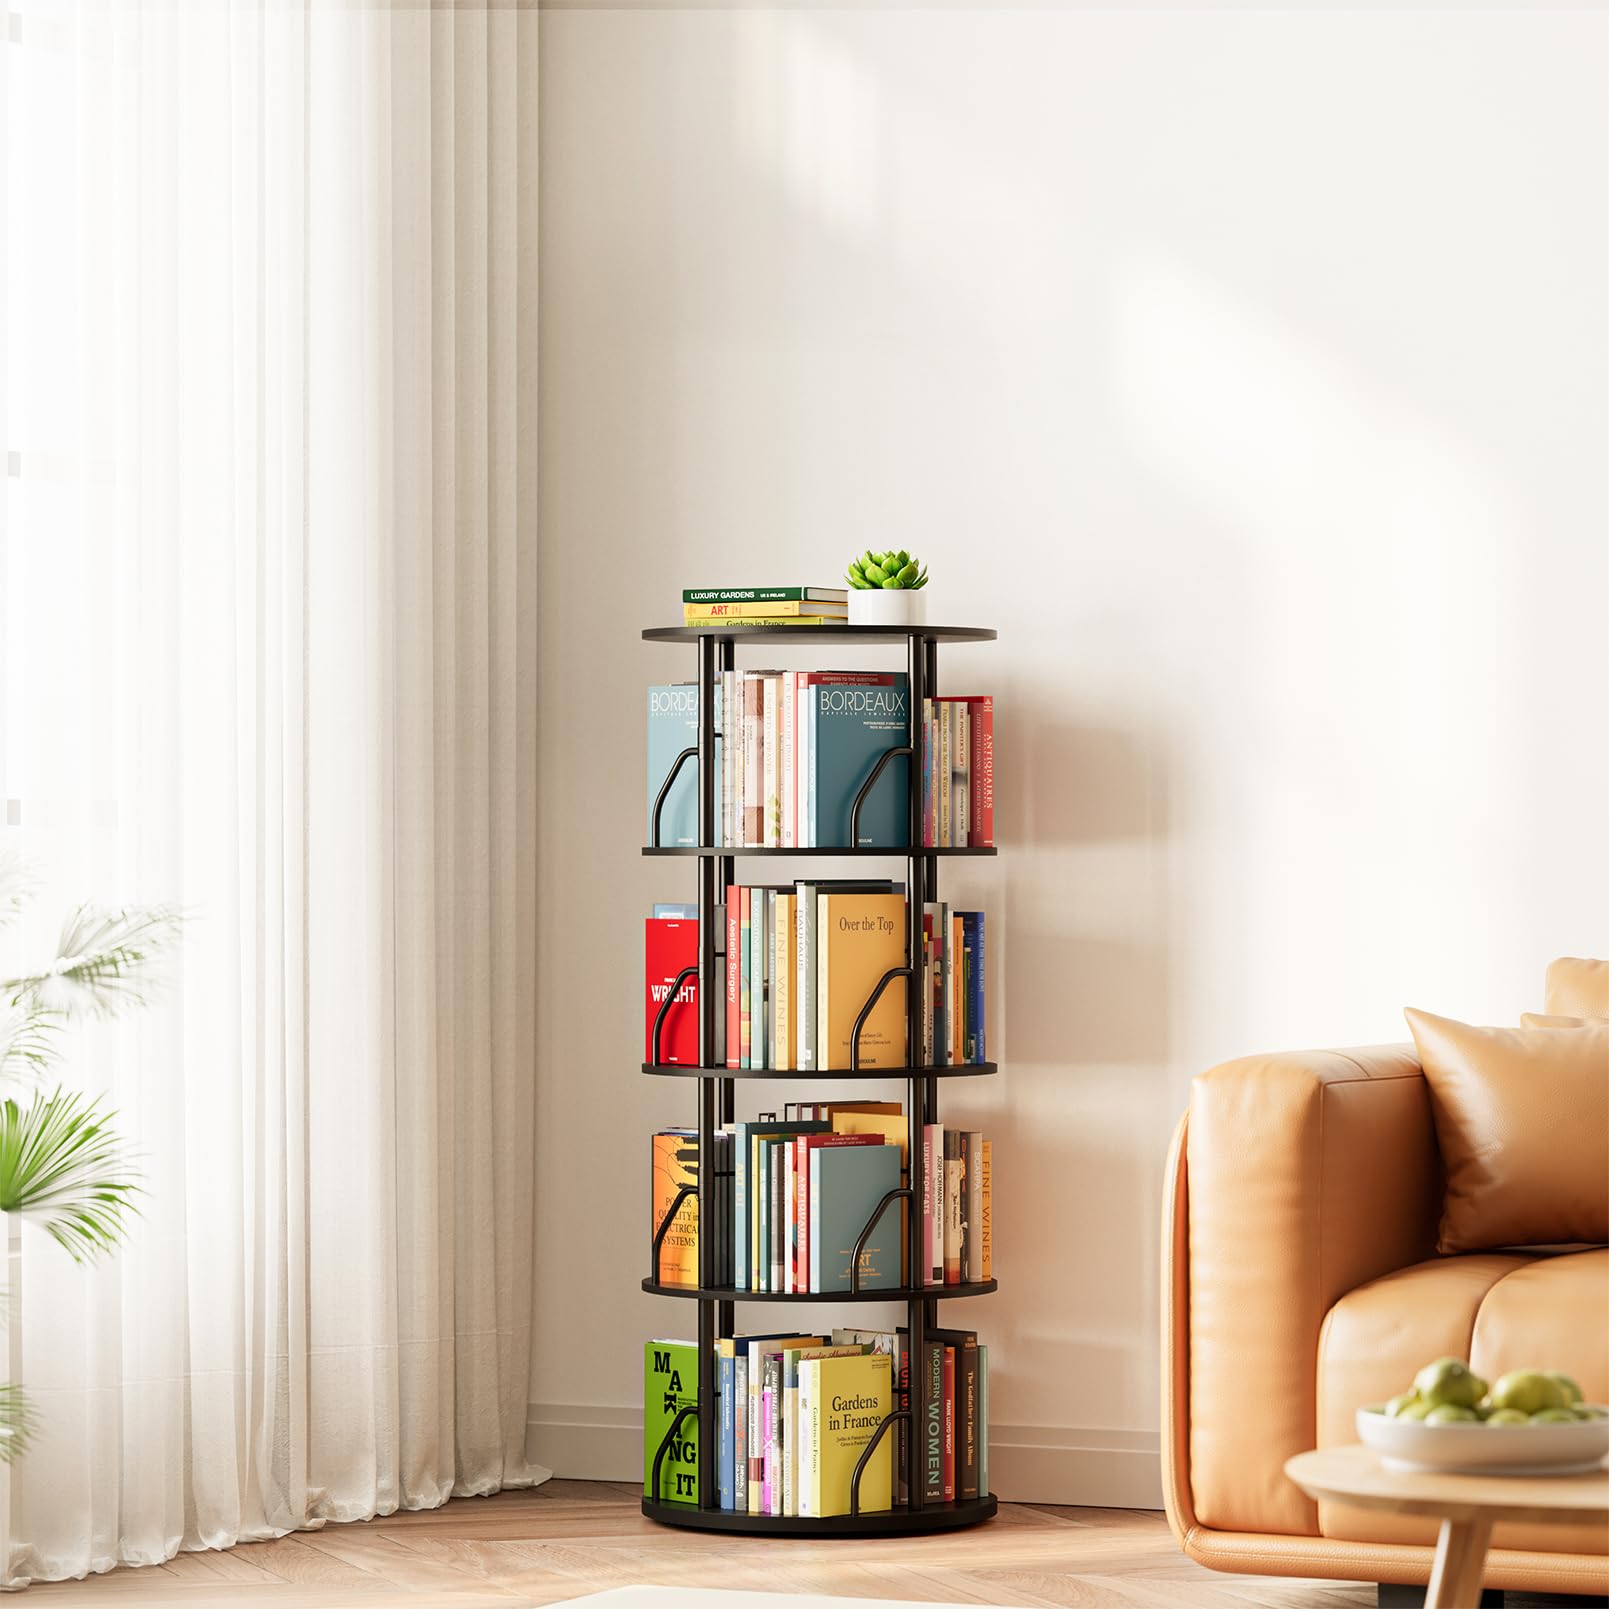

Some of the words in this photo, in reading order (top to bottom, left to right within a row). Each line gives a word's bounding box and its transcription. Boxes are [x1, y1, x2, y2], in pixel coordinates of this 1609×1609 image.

[691, 592, 719, 600] LUXURY
[720, 591, 755, 599] GARDENS
[711, 605, 729, 615] ART
[821, 690, 905, 712] BORDEAUX
[839, 917, 859, 931] Over
[861, 916, 876, 931] the
[877, 916, 894, 934] Top
[777, 919, 786, 966] FINE
[728, 962, 737, 1004] Surgery
[777, 975, 786, 1046] WINES
[974, 1151, 982, 1191] SCARPA
[665, 1197, 692, 1208] POER
[662, 1236, 696, 1247] SYSTEMS
[654, 1351, 671, 1374] M
[932, 1348, 940, 1399] MODERN
[669, 1370, 683, 1392] A
[832, 1394, 879, 1412] Gardens
[829, 1415, 841, 1431] in
[843, 1413, 881, 1430] France
[812, 1439, 818, 1448] in
[928, 1401, 940, 1485] WOMEN
[676, 1474, 696, 1497] IT
